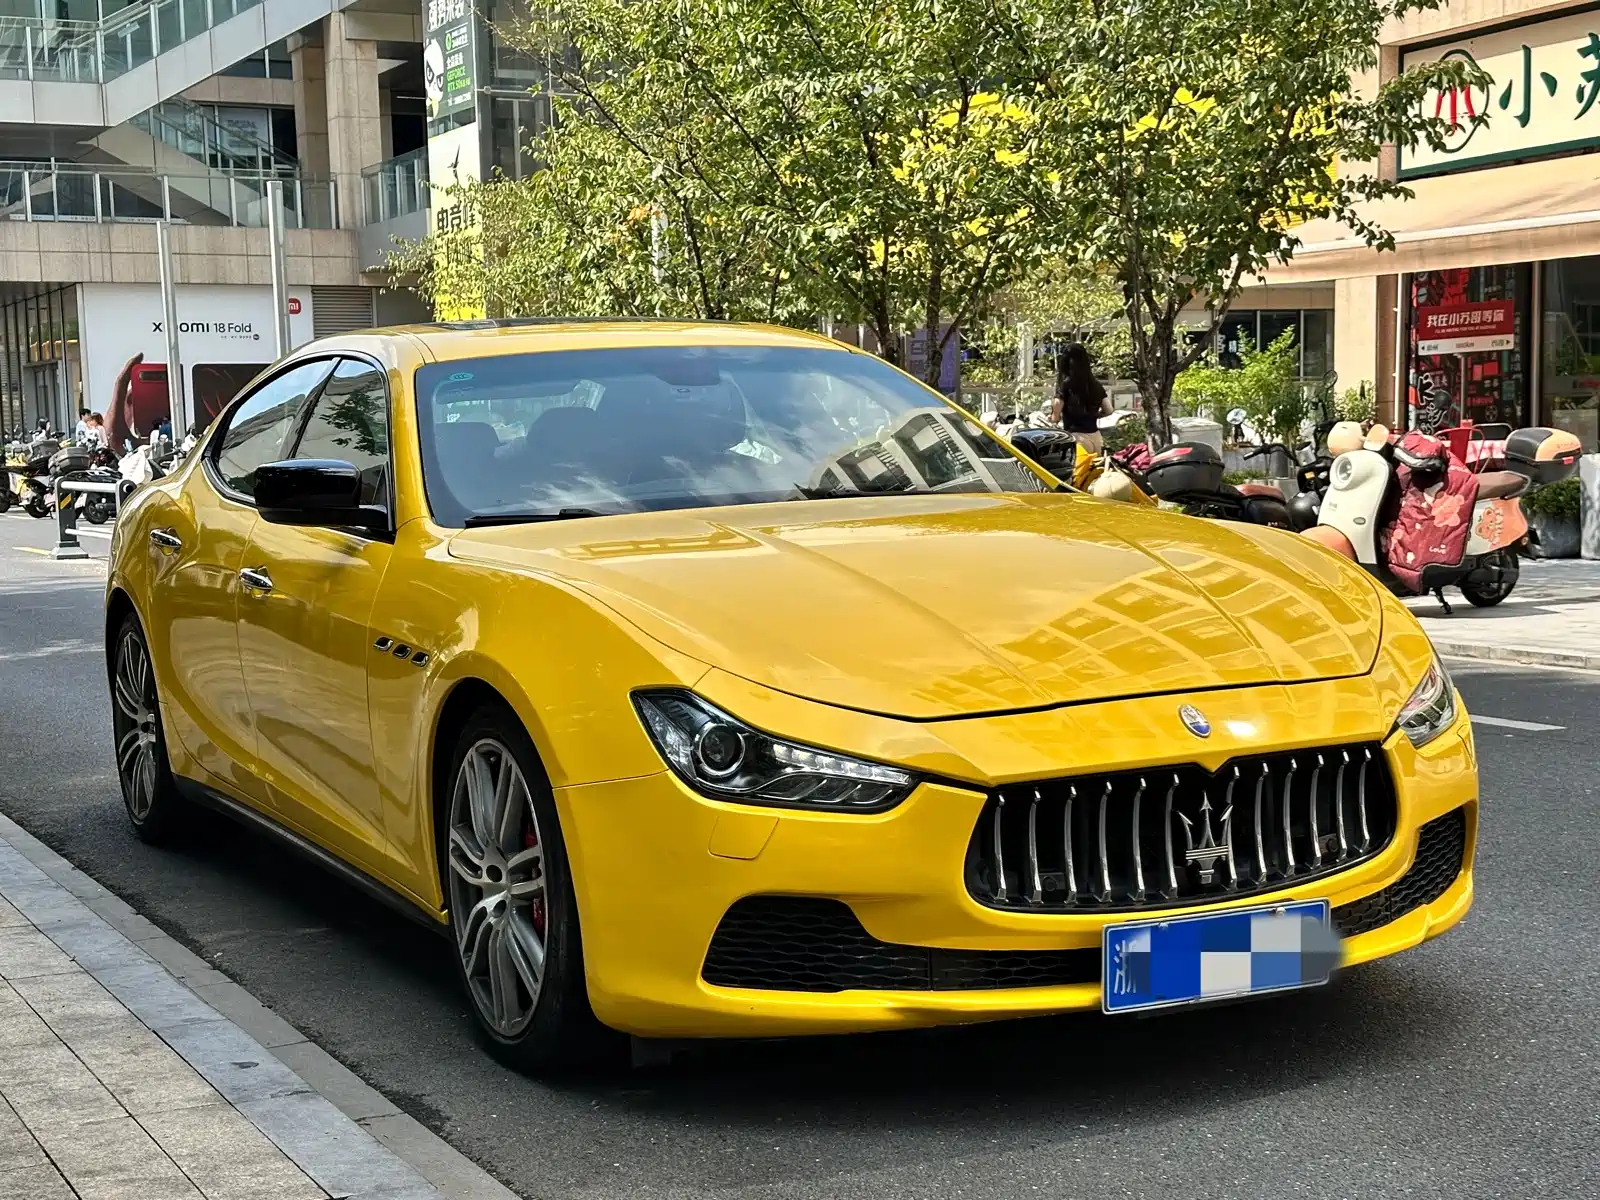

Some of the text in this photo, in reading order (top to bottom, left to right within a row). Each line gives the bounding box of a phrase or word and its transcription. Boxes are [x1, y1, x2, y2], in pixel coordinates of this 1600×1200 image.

[152, 322, 252, 334] xomi 18 Fold
